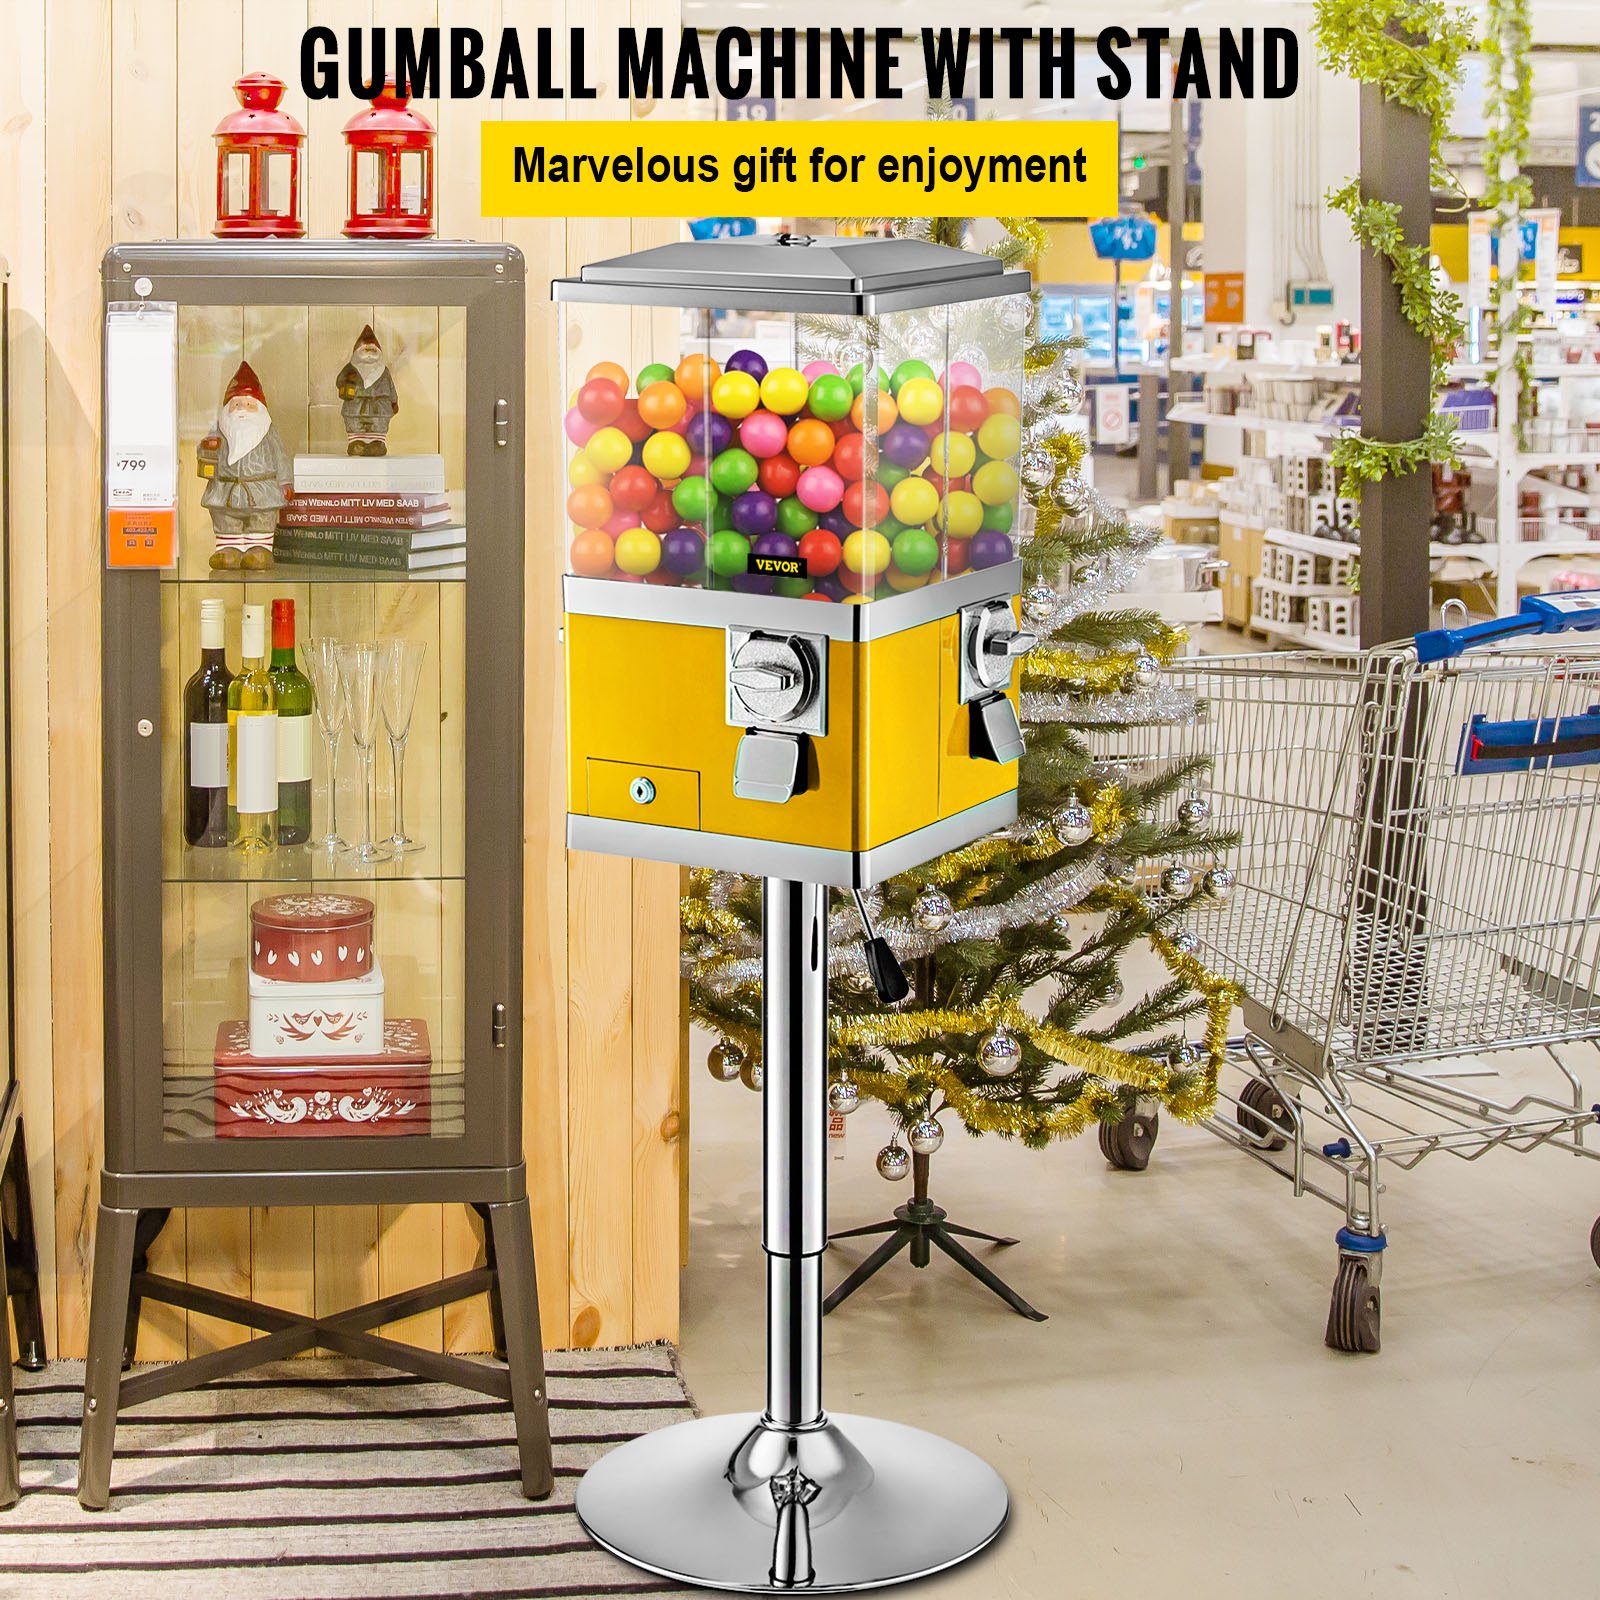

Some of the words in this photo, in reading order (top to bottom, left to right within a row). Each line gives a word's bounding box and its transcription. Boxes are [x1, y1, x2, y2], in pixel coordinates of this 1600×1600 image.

[340, 498, 361, 507] MITT
[362, 498, 376, 507] LIV
[376, 498, 394, 507] MED
[396, 499, 419, 507] SAAB
[310, 514, 327, 522] MED
[755, 559, 799, 573] VEVOR
